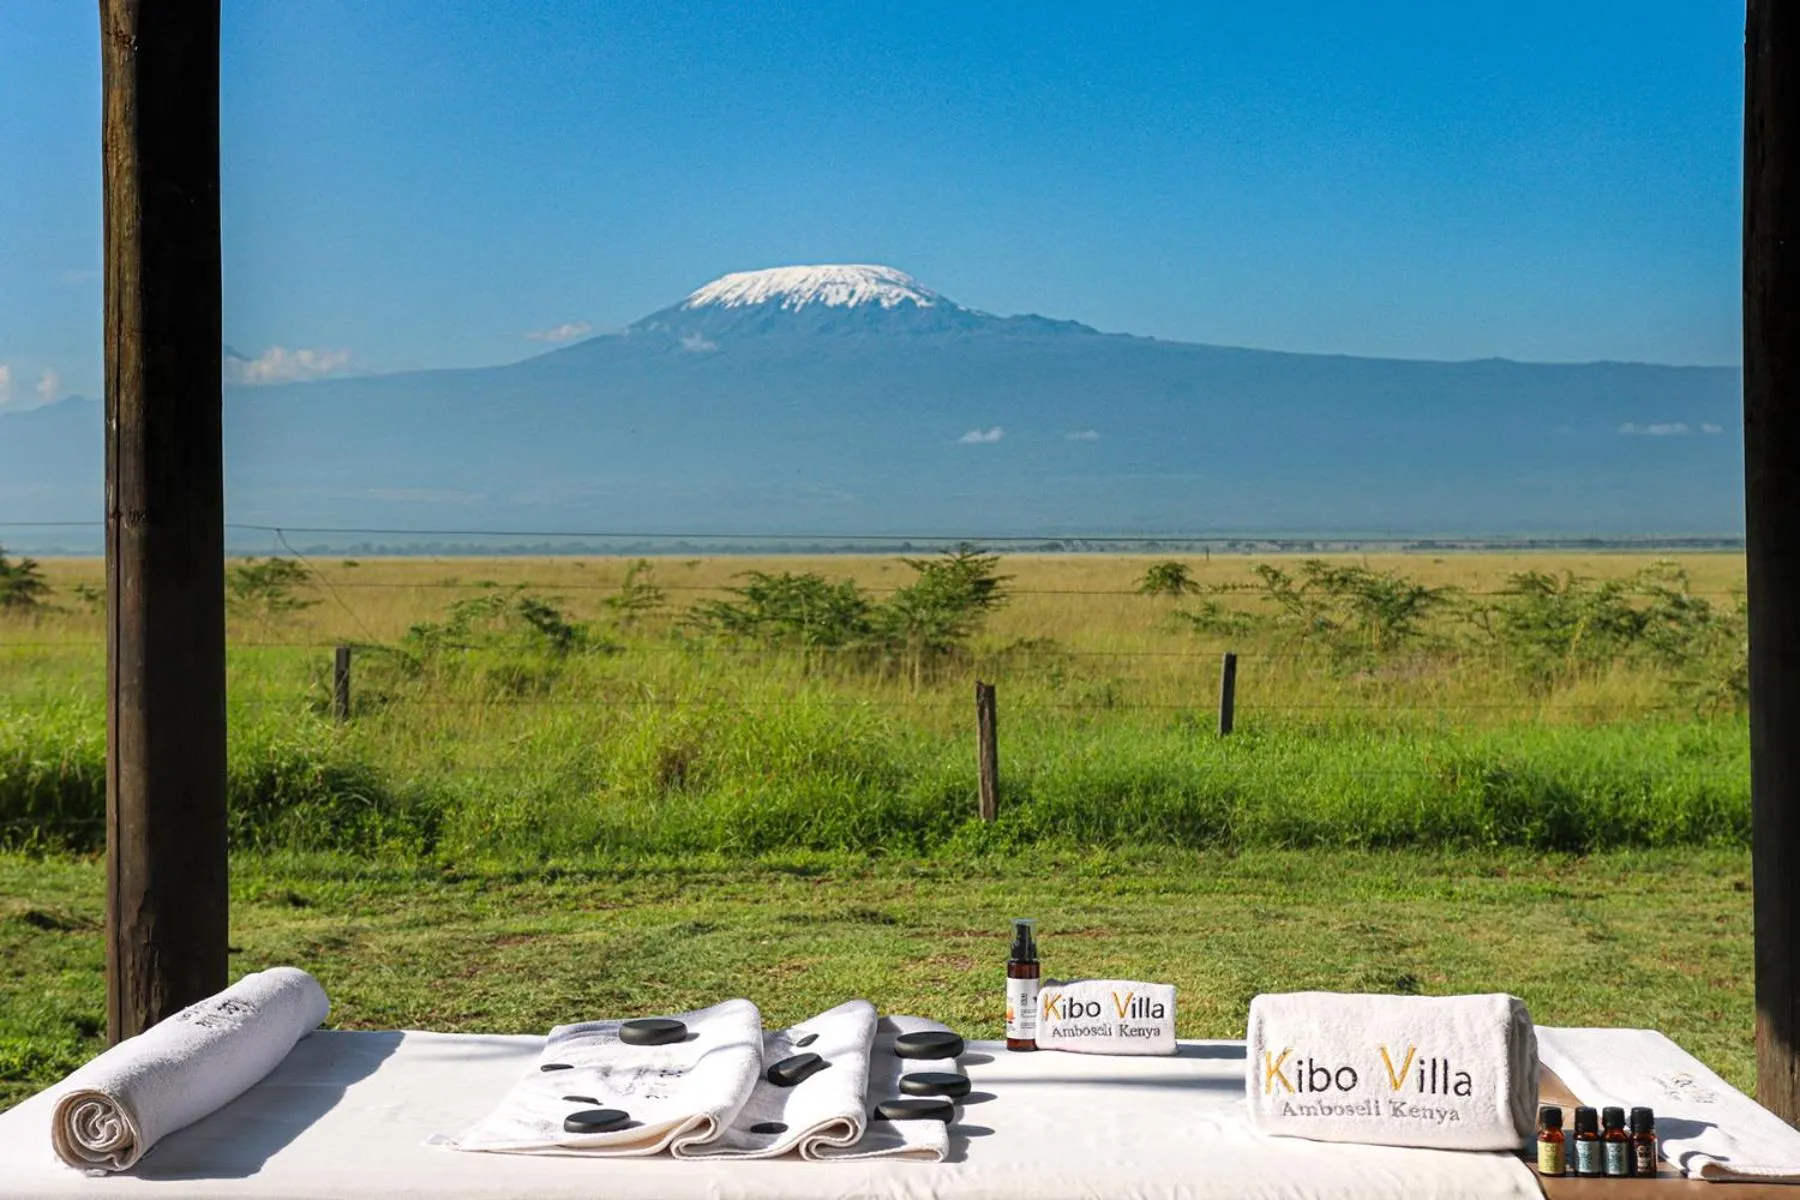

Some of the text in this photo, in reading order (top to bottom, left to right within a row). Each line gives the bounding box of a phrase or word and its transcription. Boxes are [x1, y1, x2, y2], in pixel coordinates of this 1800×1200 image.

[1042, 992, 1100, 1021] Kibo
[1112, 991, 1165, 1020] Villa
[1119, 1024, 1161, 1039] Kenya
[1264, 1043, 1472, 1097] Kibo Villa
[1282, 1100, 1460, 1125] Amboseli Kenya
